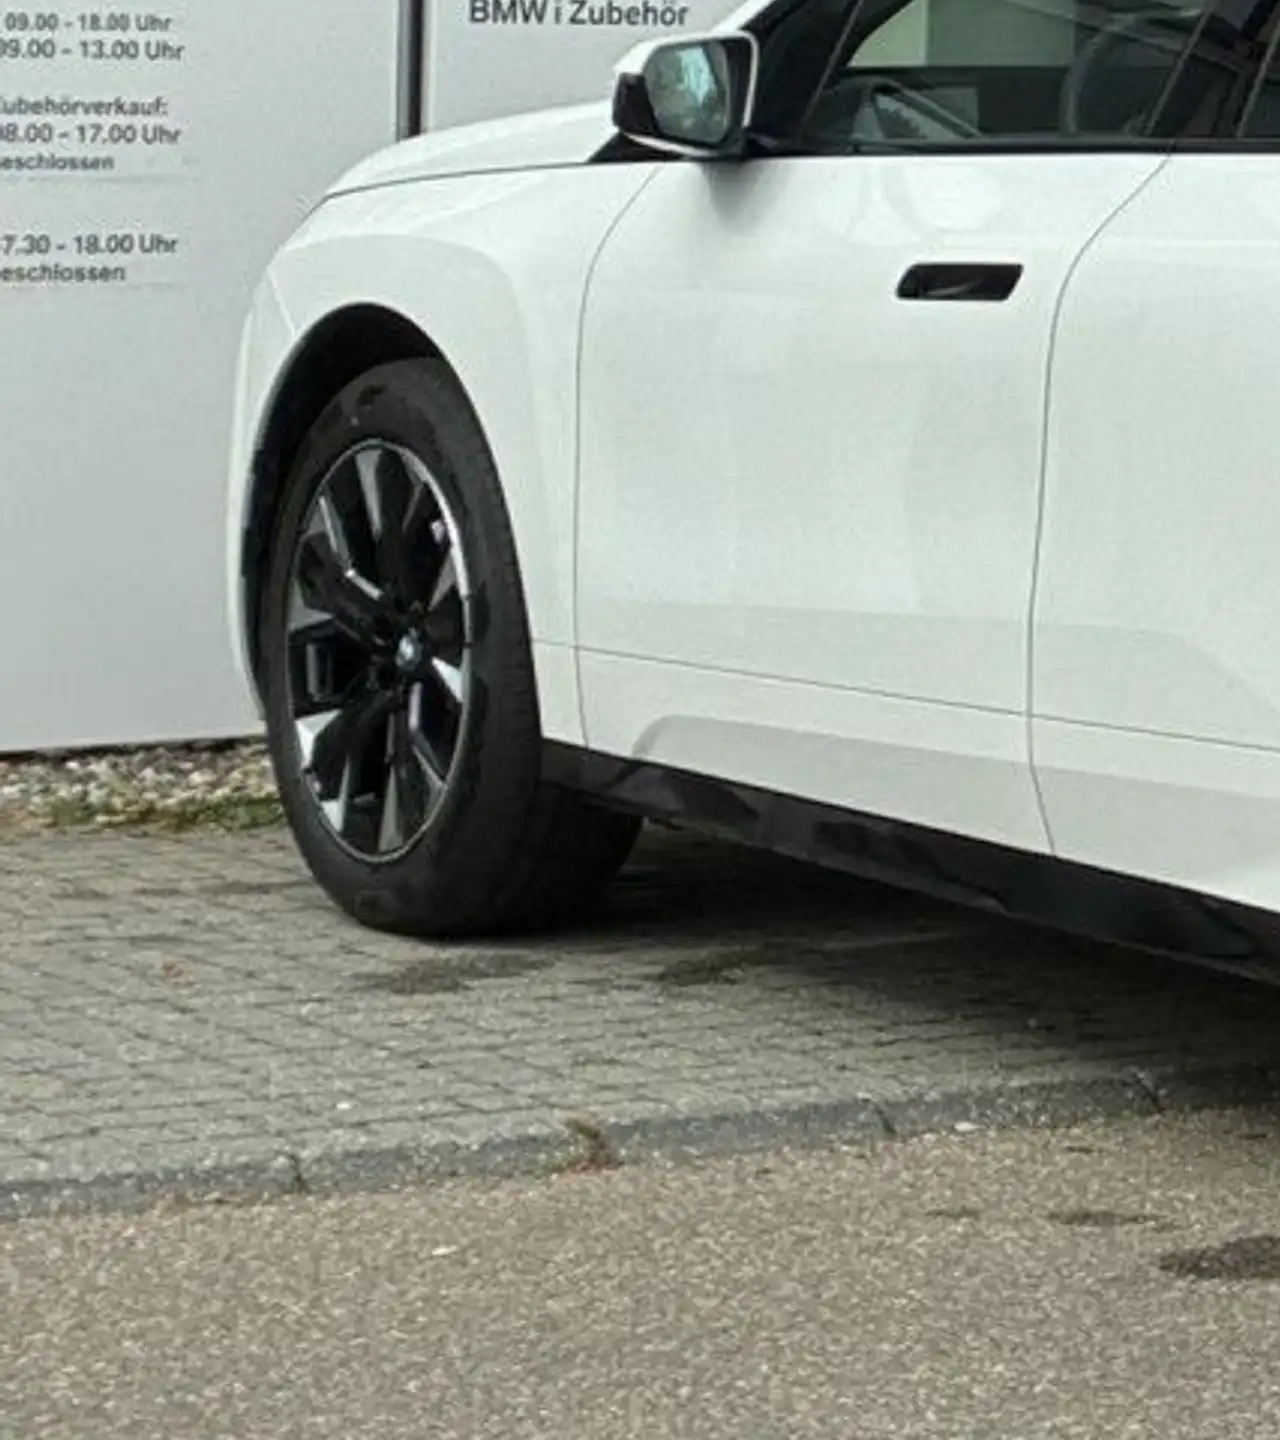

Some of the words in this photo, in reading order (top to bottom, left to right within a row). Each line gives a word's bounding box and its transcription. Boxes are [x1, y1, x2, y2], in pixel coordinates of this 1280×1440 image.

[135, 14, 173, 34] Uhr
[79, 39, 140, 60] 13.00
[144, 40, 186, 62] Uhr
[75, 124, 138, 145] 17.00
[141, 125, 182, 146] Uhr
[74, 234, 134, 256] 18.00
[138, 234, 180, 255] Uhr
